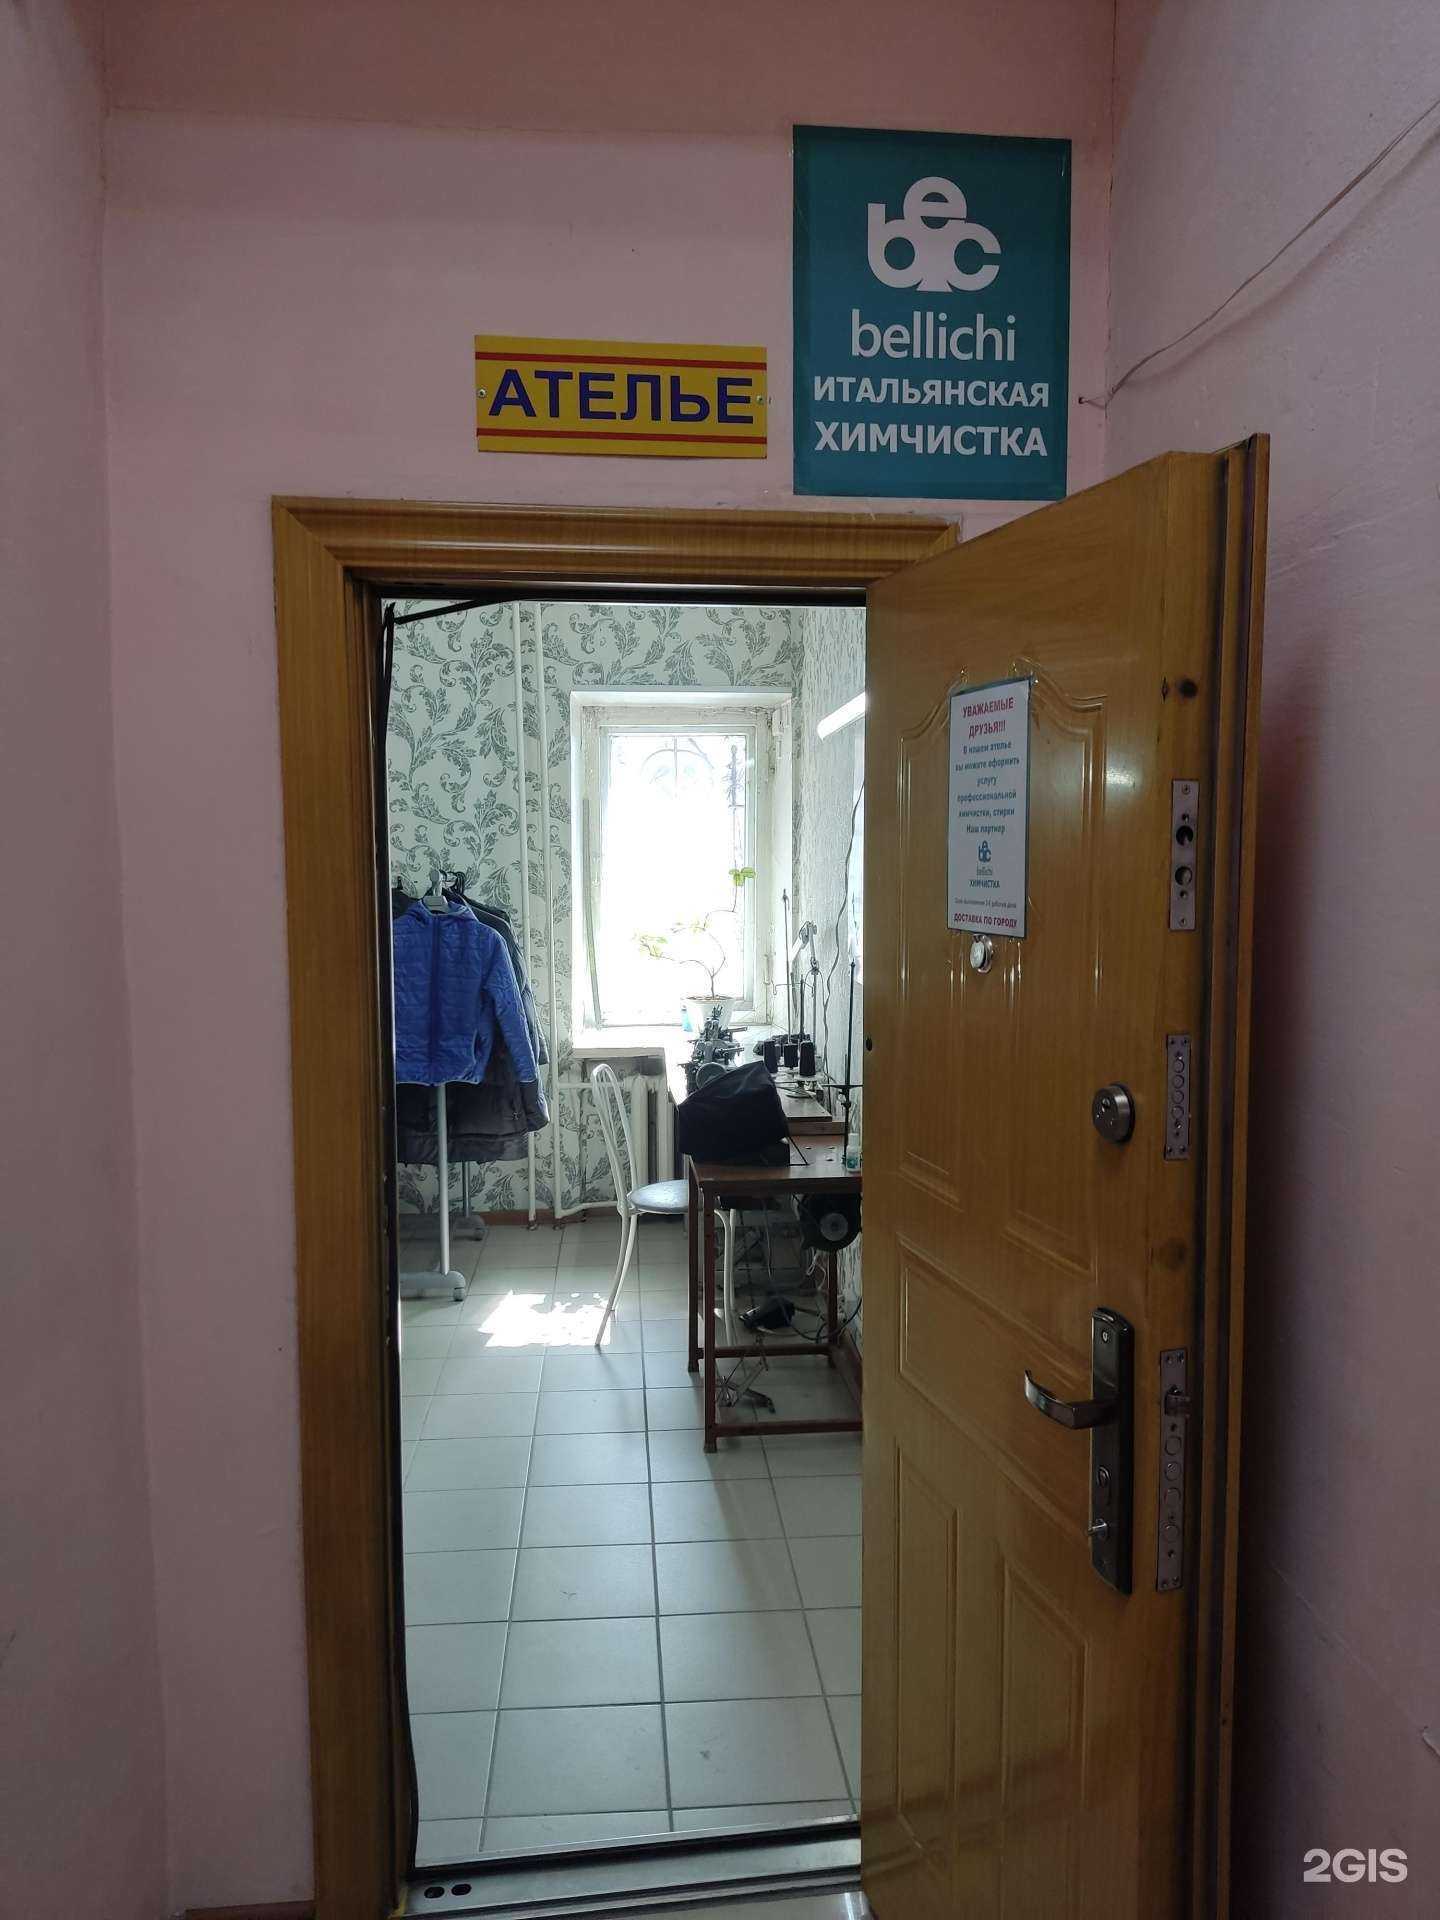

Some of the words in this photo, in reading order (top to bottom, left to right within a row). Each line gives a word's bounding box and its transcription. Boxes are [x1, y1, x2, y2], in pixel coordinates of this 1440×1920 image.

[851, 308, 1016, 361] bellichi
[488, 368, 754, 425] АТЕЛЬЕ
[813, 375, 1050, 408] ИТАЛЬЯНСКАЯ
[814, 420, 1048, 457] ХИМЧИСТКА
[962, 697, 1014, 718] УВАЖАЕМЫЕ
[968, 719, 1006, 739] ДРУЗЬЯ!!!
[988, 757, 1020, 769] оформить
[976, 776, 998, 787] услугу
[957, 789, 1017, 804] профессиональной
[966, 823, 979, 833] Наш
[969, 879, 1001, 889] ХИМЧИСТКА
[953, 912, 982, 924] ДОСТАВКА
[983, 916, 993, 925] ПО
[993, 916, 1018, 929] ГОРОДУ
